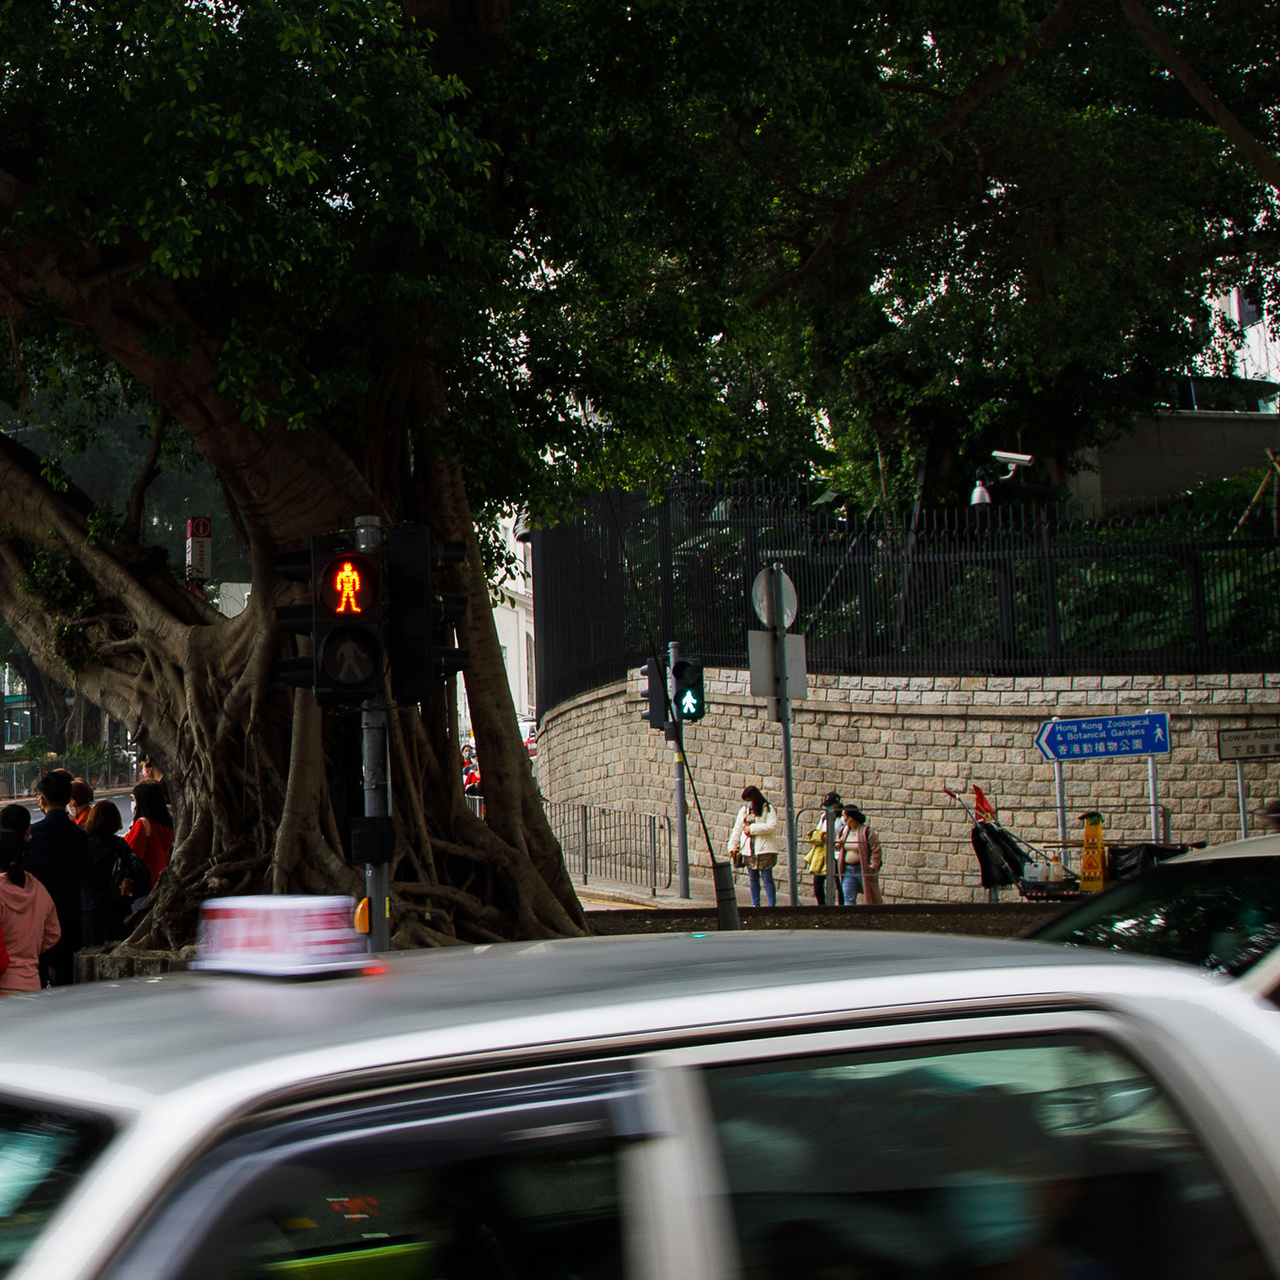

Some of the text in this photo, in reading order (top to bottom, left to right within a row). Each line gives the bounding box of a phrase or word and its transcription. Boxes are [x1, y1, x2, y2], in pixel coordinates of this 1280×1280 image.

[196, 540, 205, 574] Central
[1055, 717, 1150, 733] Hong Kong Zoological
[1056, 728, 1146, 741] & Botanical Gardens
[1221, 733, 1250, 742] Lower
[1057, 739, 1143, 755] 香港動植物公園
